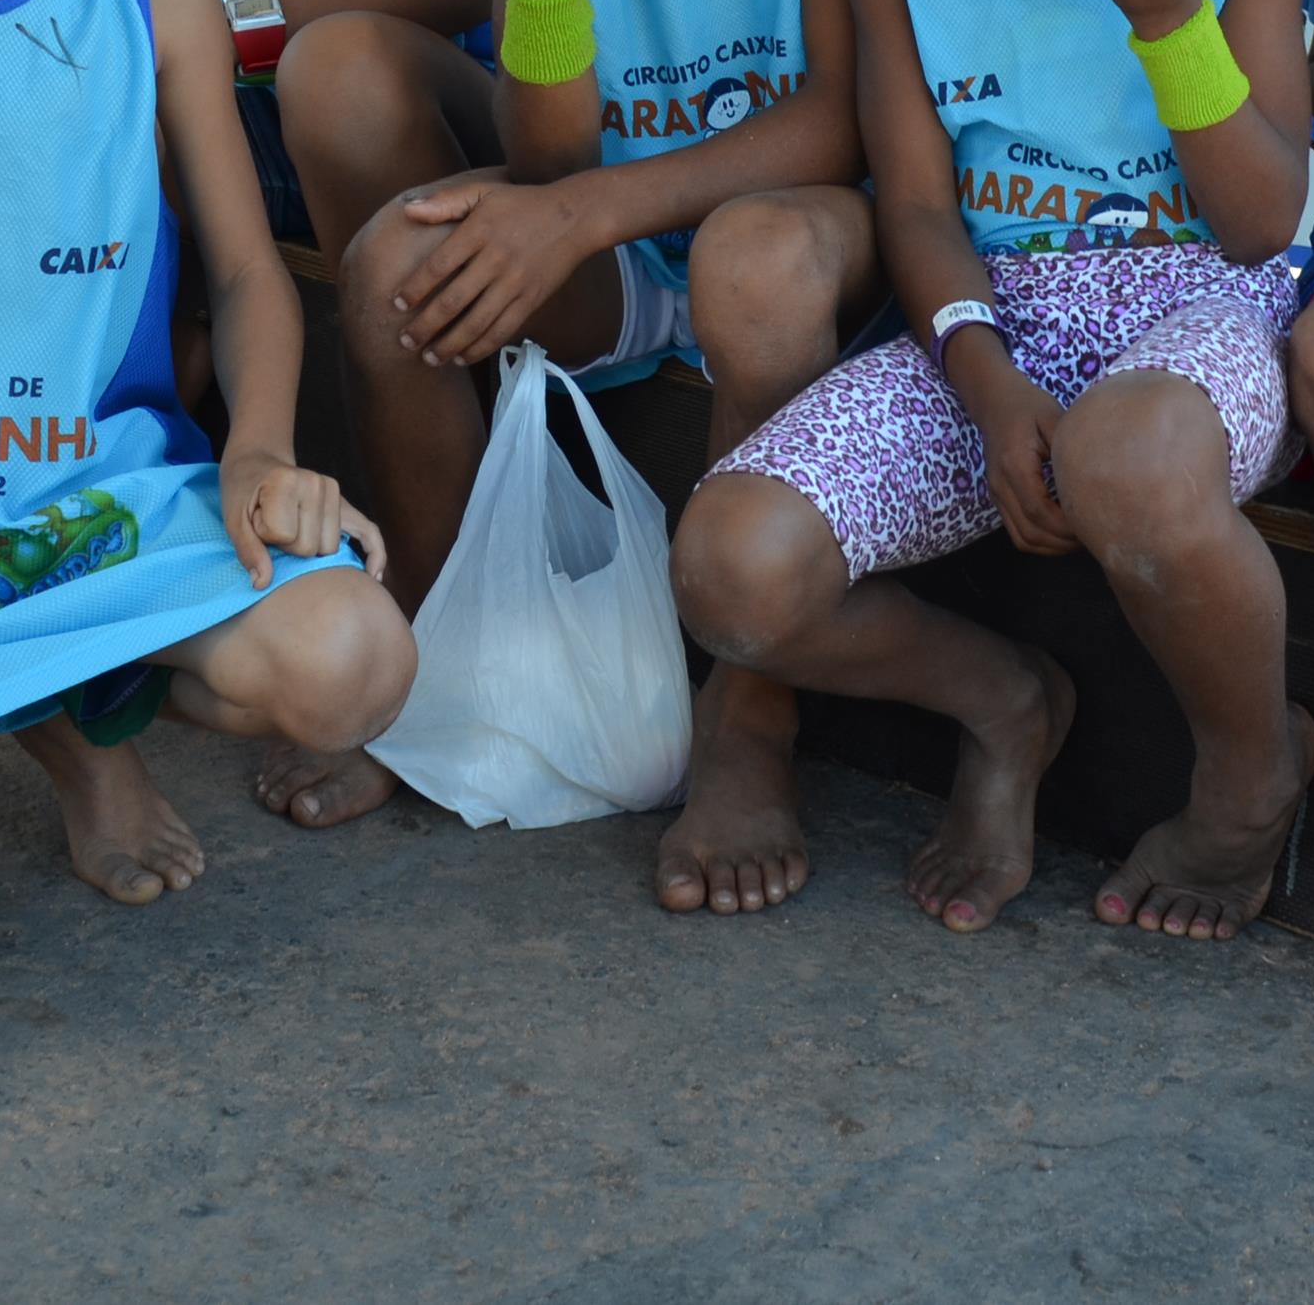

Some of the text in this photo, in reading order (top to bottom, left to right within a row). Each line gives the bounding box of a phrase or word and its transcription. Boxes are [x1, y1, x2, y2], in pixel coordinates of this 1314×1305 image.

[623, 55, 711, 87] CIRCUITO
[1117, 147, 1178, 181] CAIX
[39, 241, 130, 275] CAIX
[8, 376, 44, 399] DE
